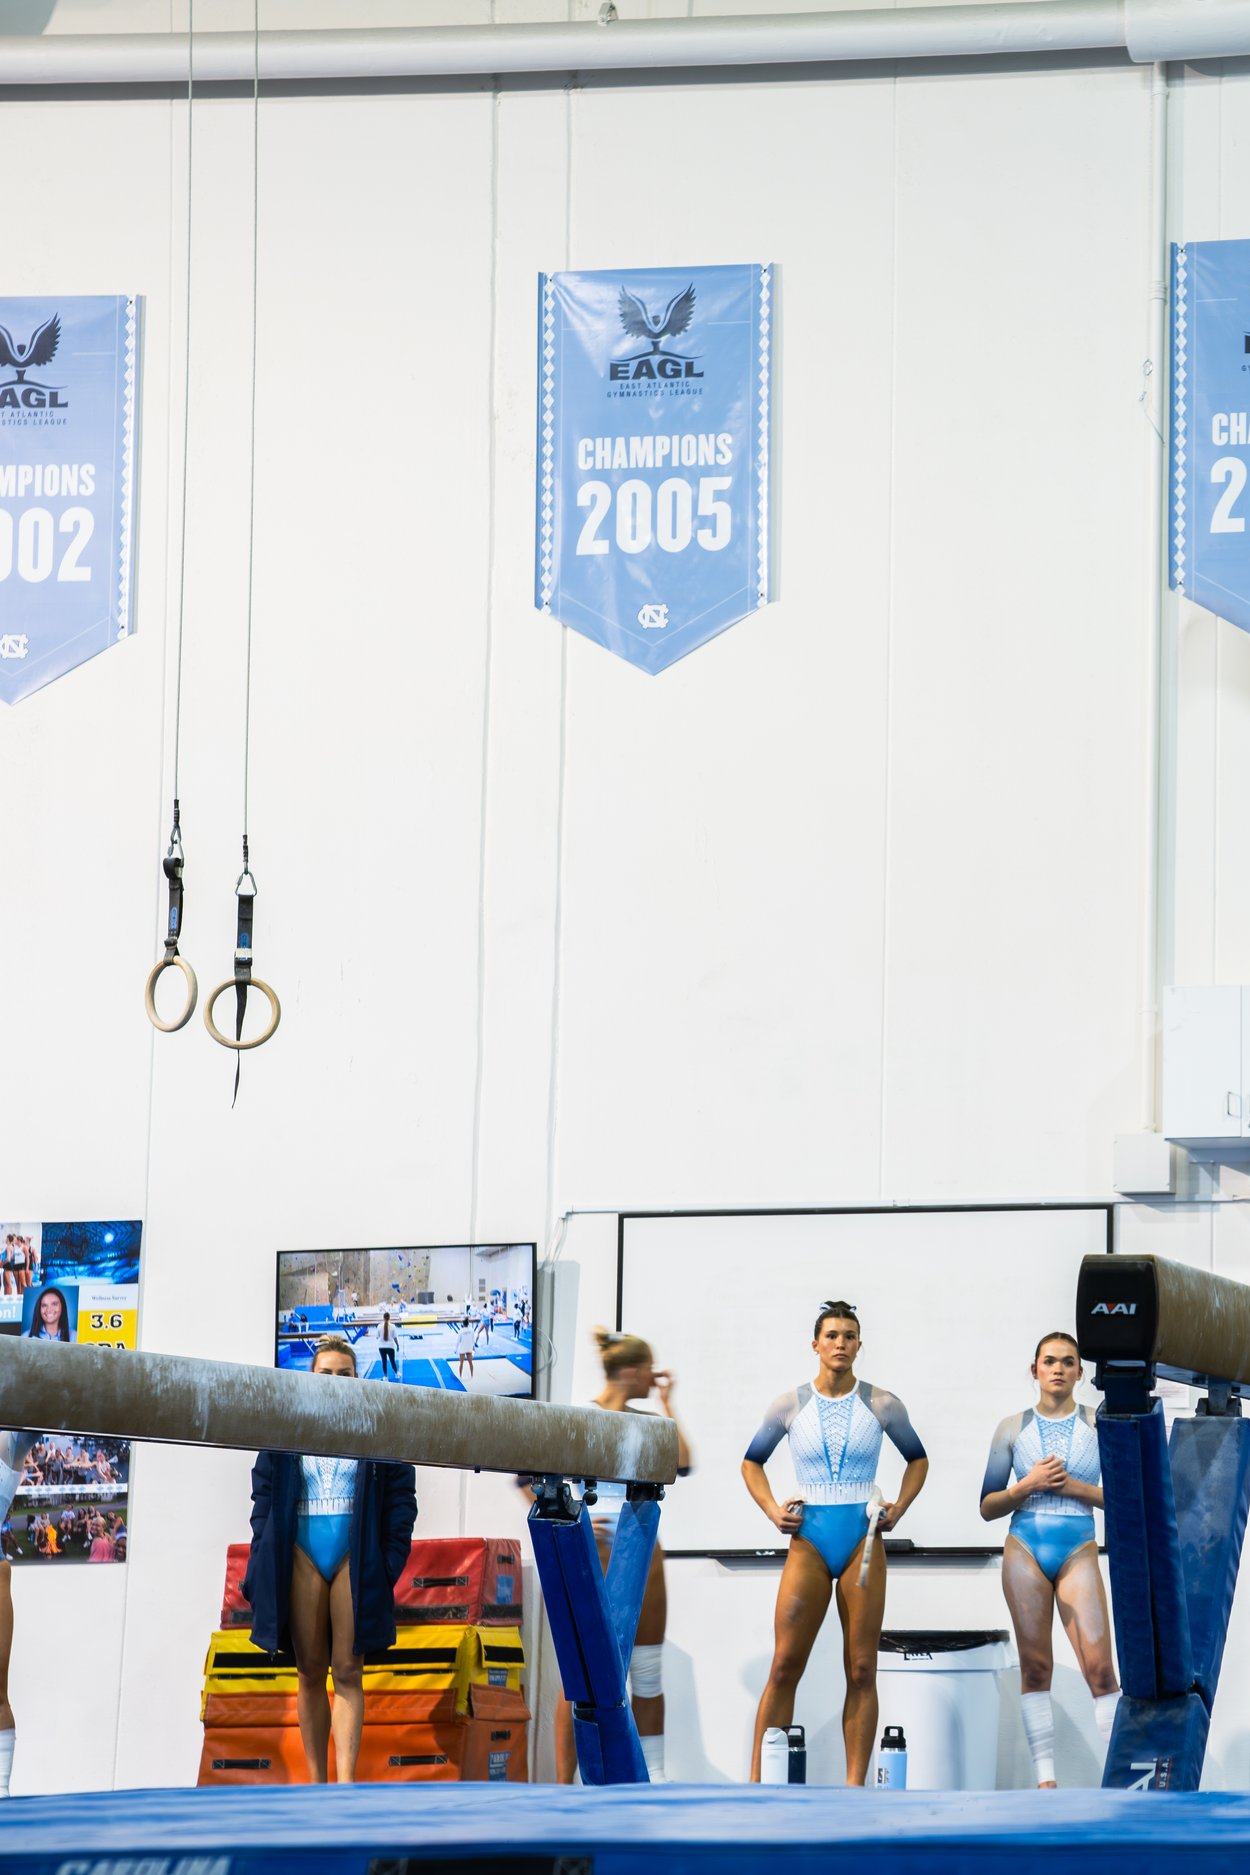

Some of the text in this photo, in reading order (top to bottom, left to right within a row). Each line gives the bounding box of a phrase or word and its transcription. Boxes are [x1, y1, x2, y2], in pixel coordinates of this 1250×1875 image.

[609, 358, 704, 381] EAGL
[606, 388, 703, 398] GYMNASTICS LEAGUE
[620, 381, 690, 390] EAST ATLANTIC
[0, 387, 69, 409] AGL
[33, 418, 67, 426] LEAGUE
[577, 432, 733, 471] CHAMPIONS
[0, 463, 96, 497] MPIONS
[575, 476, 733, 556] 2005
[0, 506, 95, 583] 02
[91, 1313, 123, 1329] 3.6
